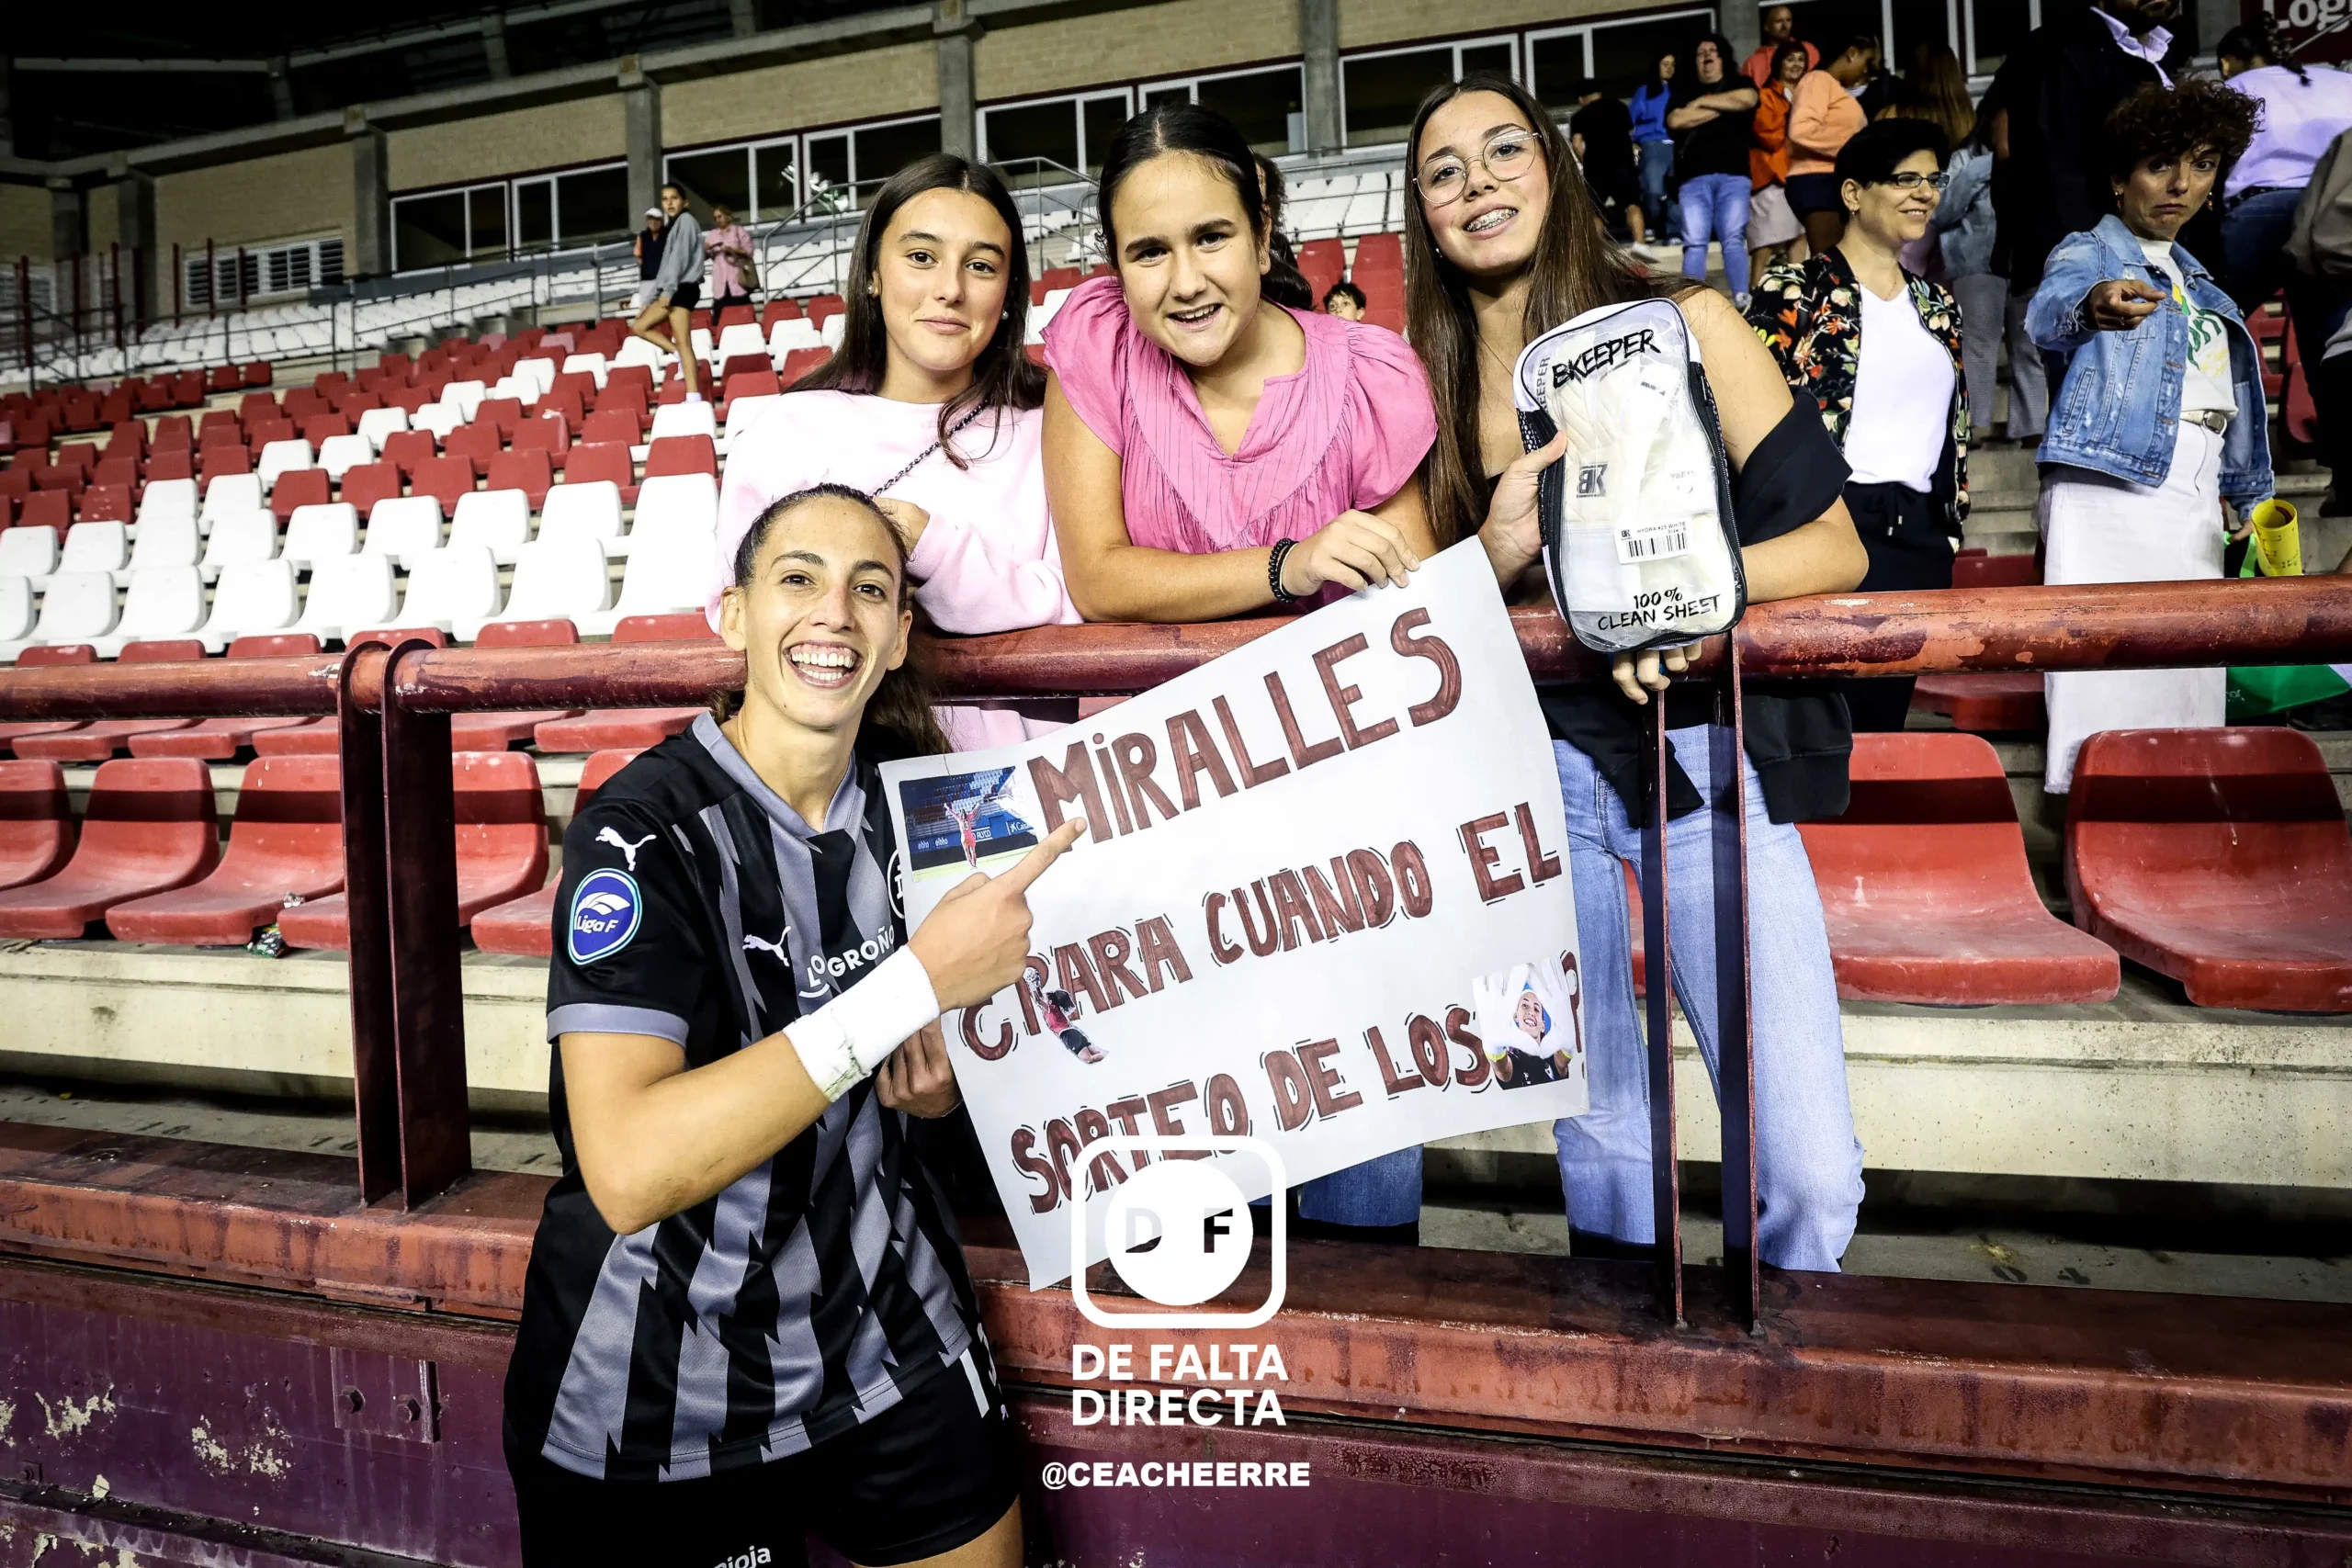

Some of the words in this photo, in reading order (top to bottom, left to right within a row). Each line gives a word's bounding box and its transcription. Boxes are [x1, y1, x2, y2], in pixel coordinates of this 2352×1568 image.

[1552, 329, 1661, 389] BKEEPER
[1668, 521, 1686, 529] WHITE
[1598, 608, 1657, 631] CLEAN
[1663, 593, 1721, 621] SHEET
[1204, 840, 1433, 966] CUANDO
[1459, 801, 1562, 904] EL
[576, 914, 606, 934] Liga
[604, 919, 620, 933] F
[806, 924, 896, 988] LOGROÑO
[1011, 1072, 1252, 1214] SORTEO
[1264, 1037, 1364, 1133] DE
[1365, 1006, 1491, 1097] LOS
[714, 1545, 772, 1568] ioja
